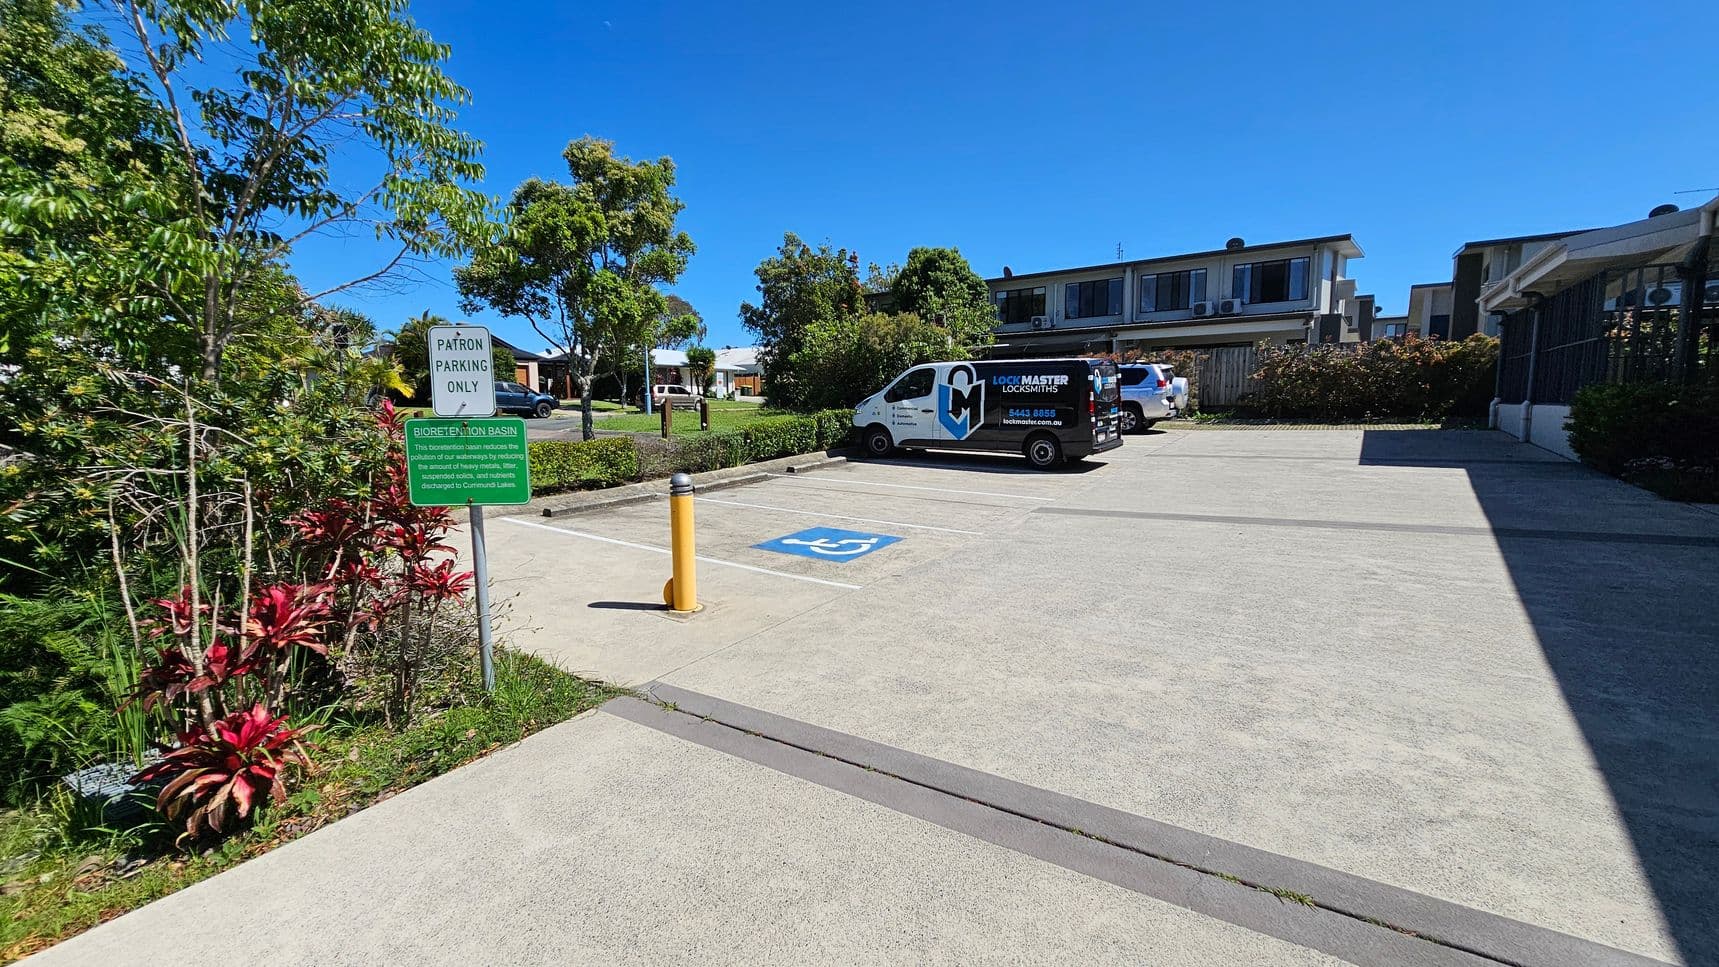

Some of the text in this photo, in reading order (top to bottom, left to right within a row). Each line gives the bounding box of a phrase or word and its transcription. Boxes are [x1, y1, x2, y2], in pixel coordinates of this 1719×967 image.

[437, 338, 483, 351] PATRON
[435, 359, 488, 372] PARKING
[447, 380, 479, 393] ONLY
[1002, 384, 1058, 393] LOCKSMITHS
[1008, 408, 1031, 417] 5443
[1002, 418, 1063, 426] lockmaster.com.au
[413, 426, 518, 436] BIORETENTION BASIN
[456, 453, 488, 461] waterways
[489, 453, 497, 461] by
[497, 453, 525, 461] reducing
[421, 482, 455, 490] discharged
